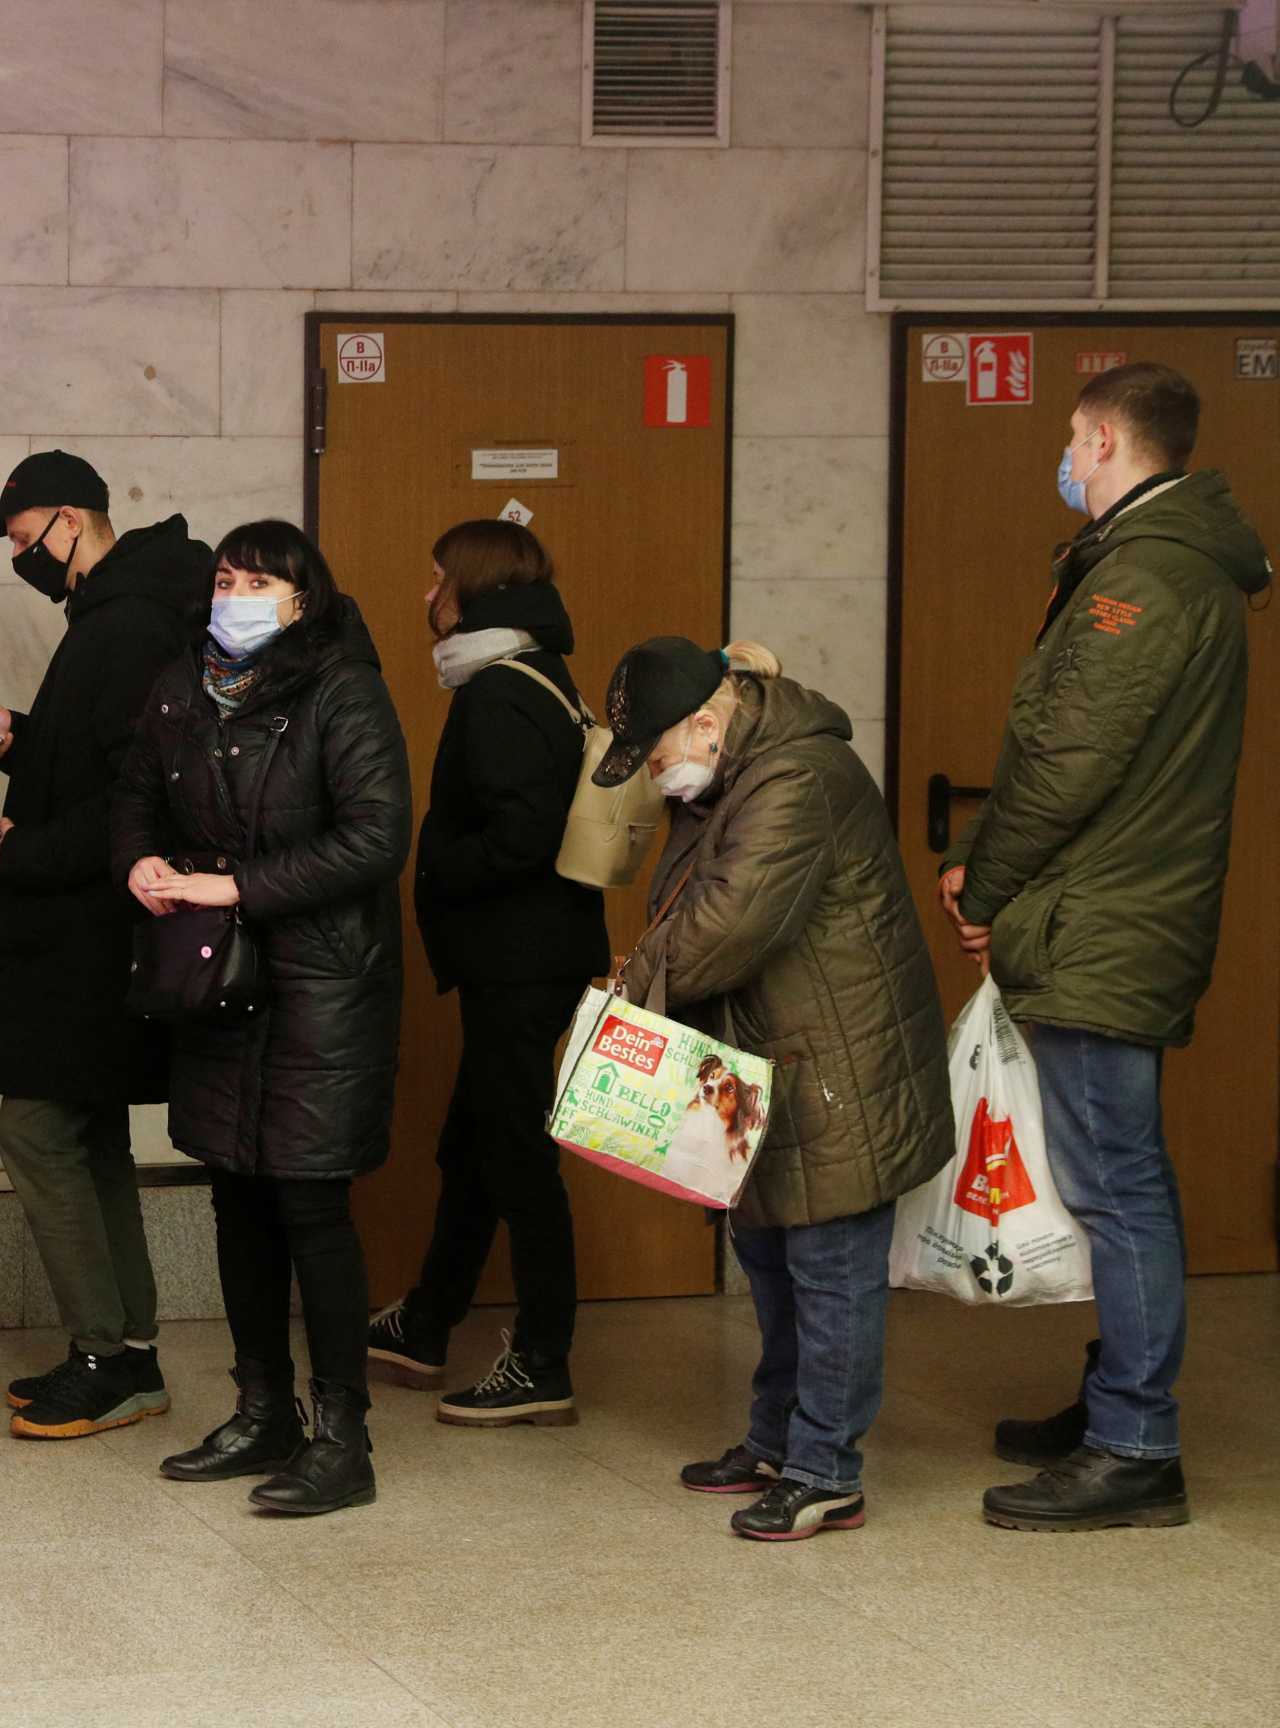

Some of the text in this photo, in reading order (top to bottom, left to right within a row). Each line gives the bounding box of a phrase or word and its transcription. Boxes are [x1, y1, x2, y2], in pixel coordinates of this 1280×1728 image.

[356, 341, 365, 354] В
[598, 1034, 656, 1072] Bestes
[612, 1024, 651, 1053] Dein
